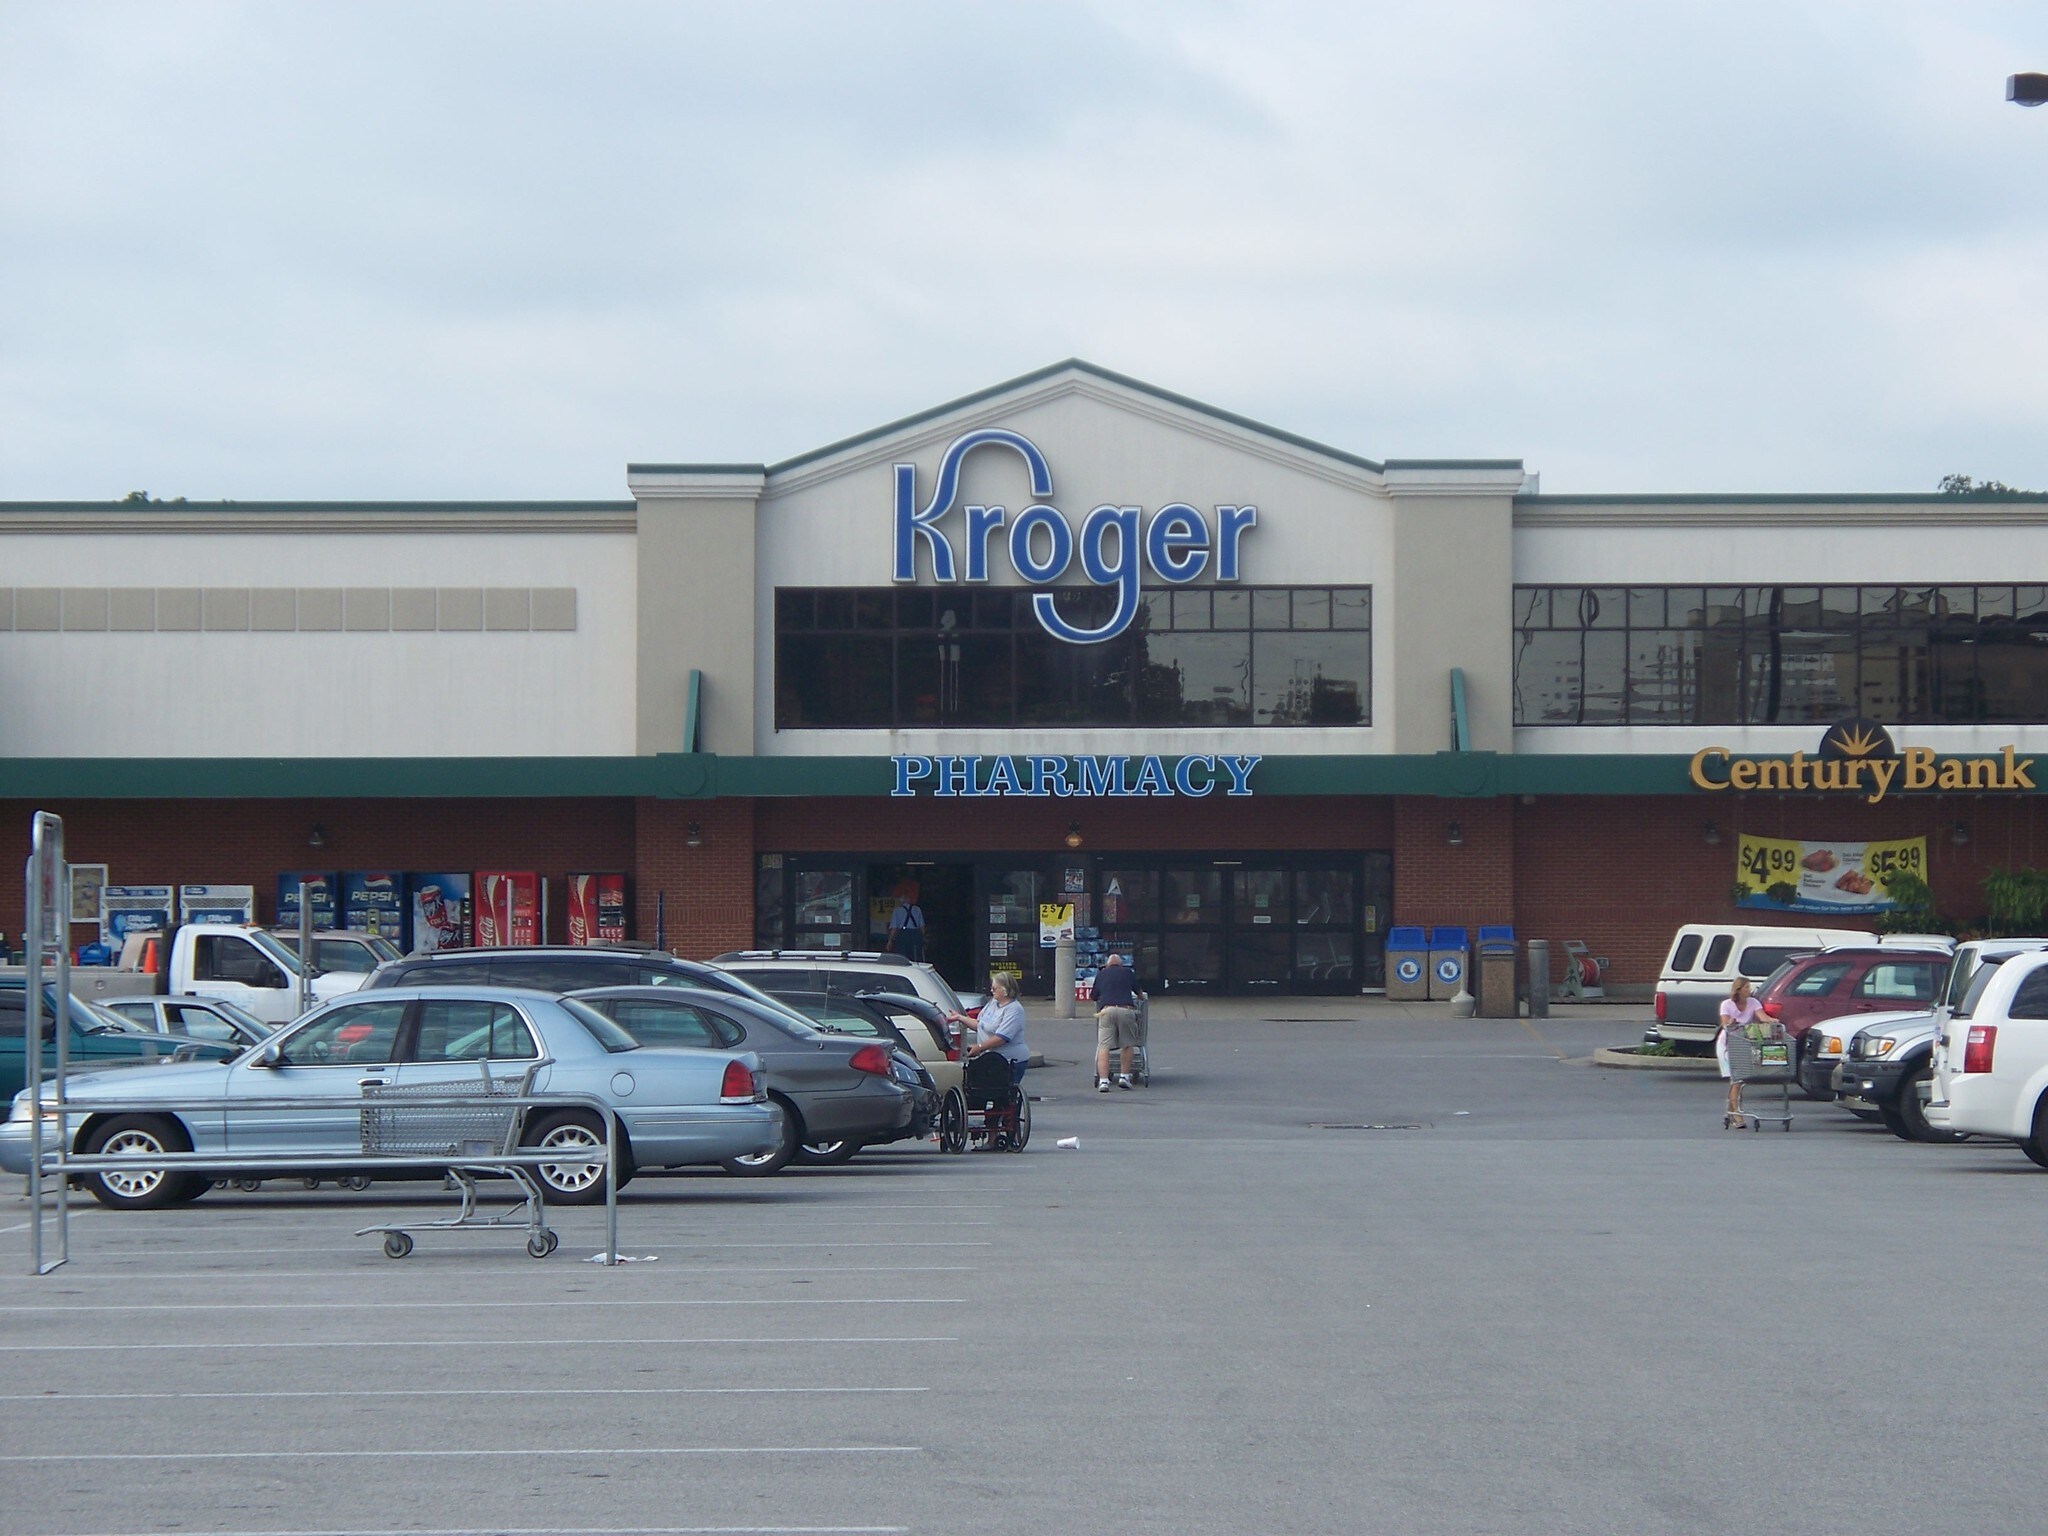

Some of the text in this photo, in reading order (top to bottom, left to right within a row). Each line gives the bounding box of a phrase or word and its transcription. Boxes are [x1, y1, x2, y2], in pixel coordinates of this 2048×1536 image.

[891, 427, 1257, 644] Kroger
[890, 754, 1262, 798] PHARMACY
[1690, 744, 2036, 803] Century Bank
[284, 893, 327, 902] PESI
[351, 891, 393, 901] PEPSI
